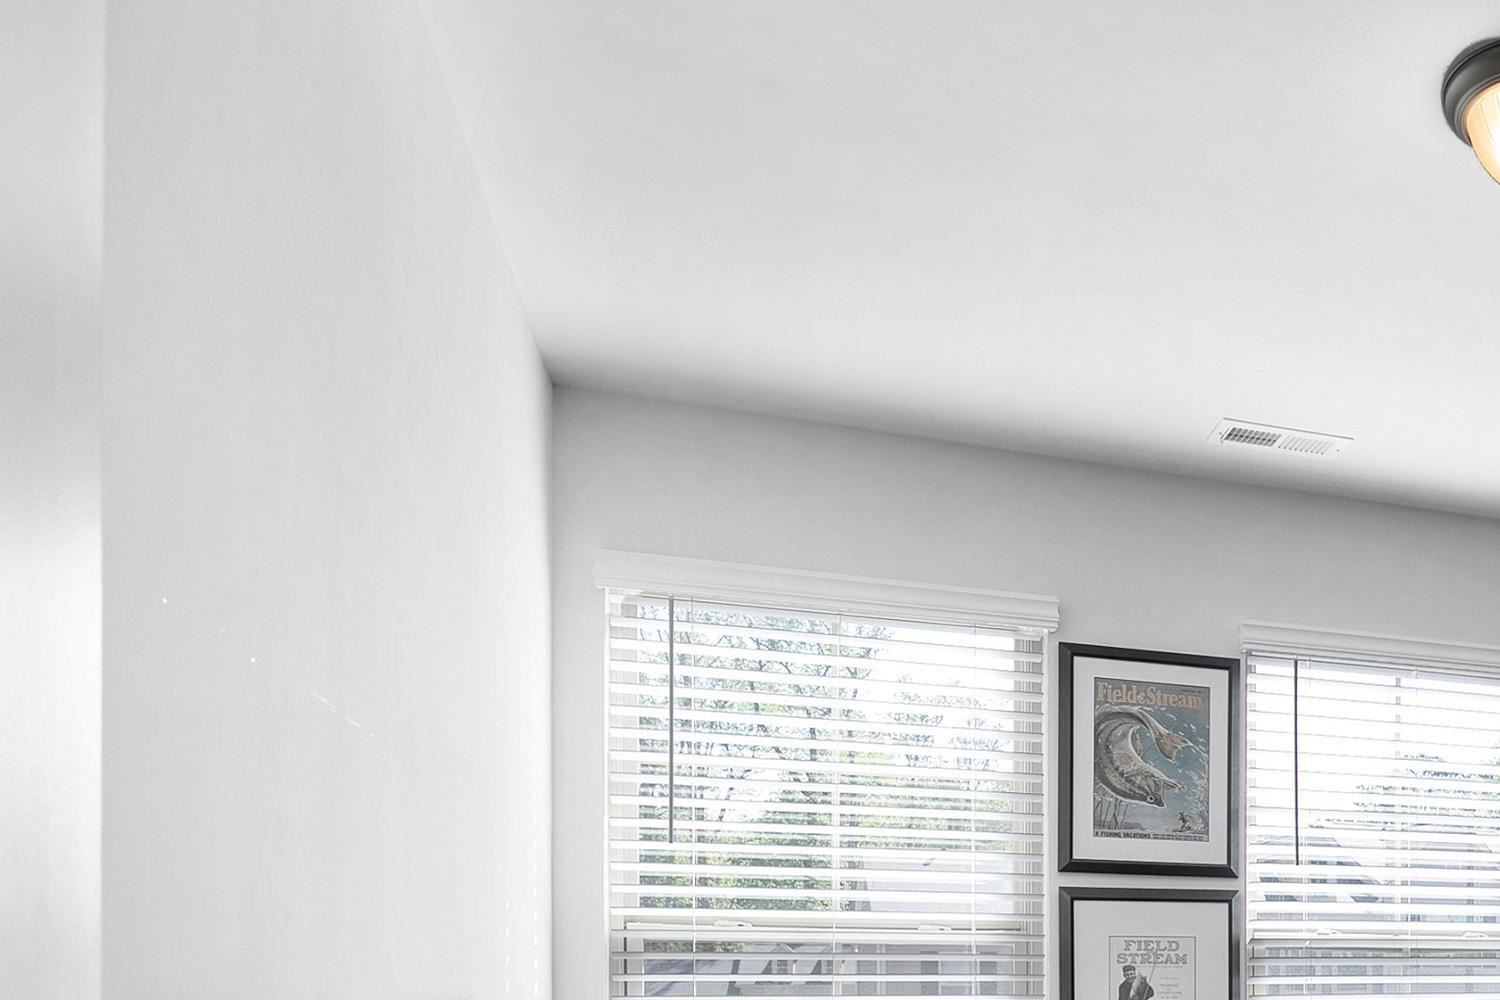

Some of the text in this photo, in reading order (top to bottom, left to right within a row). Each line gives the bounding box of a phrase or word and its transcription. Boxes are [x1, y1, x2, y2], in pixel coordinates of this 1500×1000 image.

[1096, 682, 1137, 703] Field
[1146, 687, 1201, 709] Stream
[1124, 940, 1181, 952] FIELD
[1116, 953, 1188, 965] STREAM
